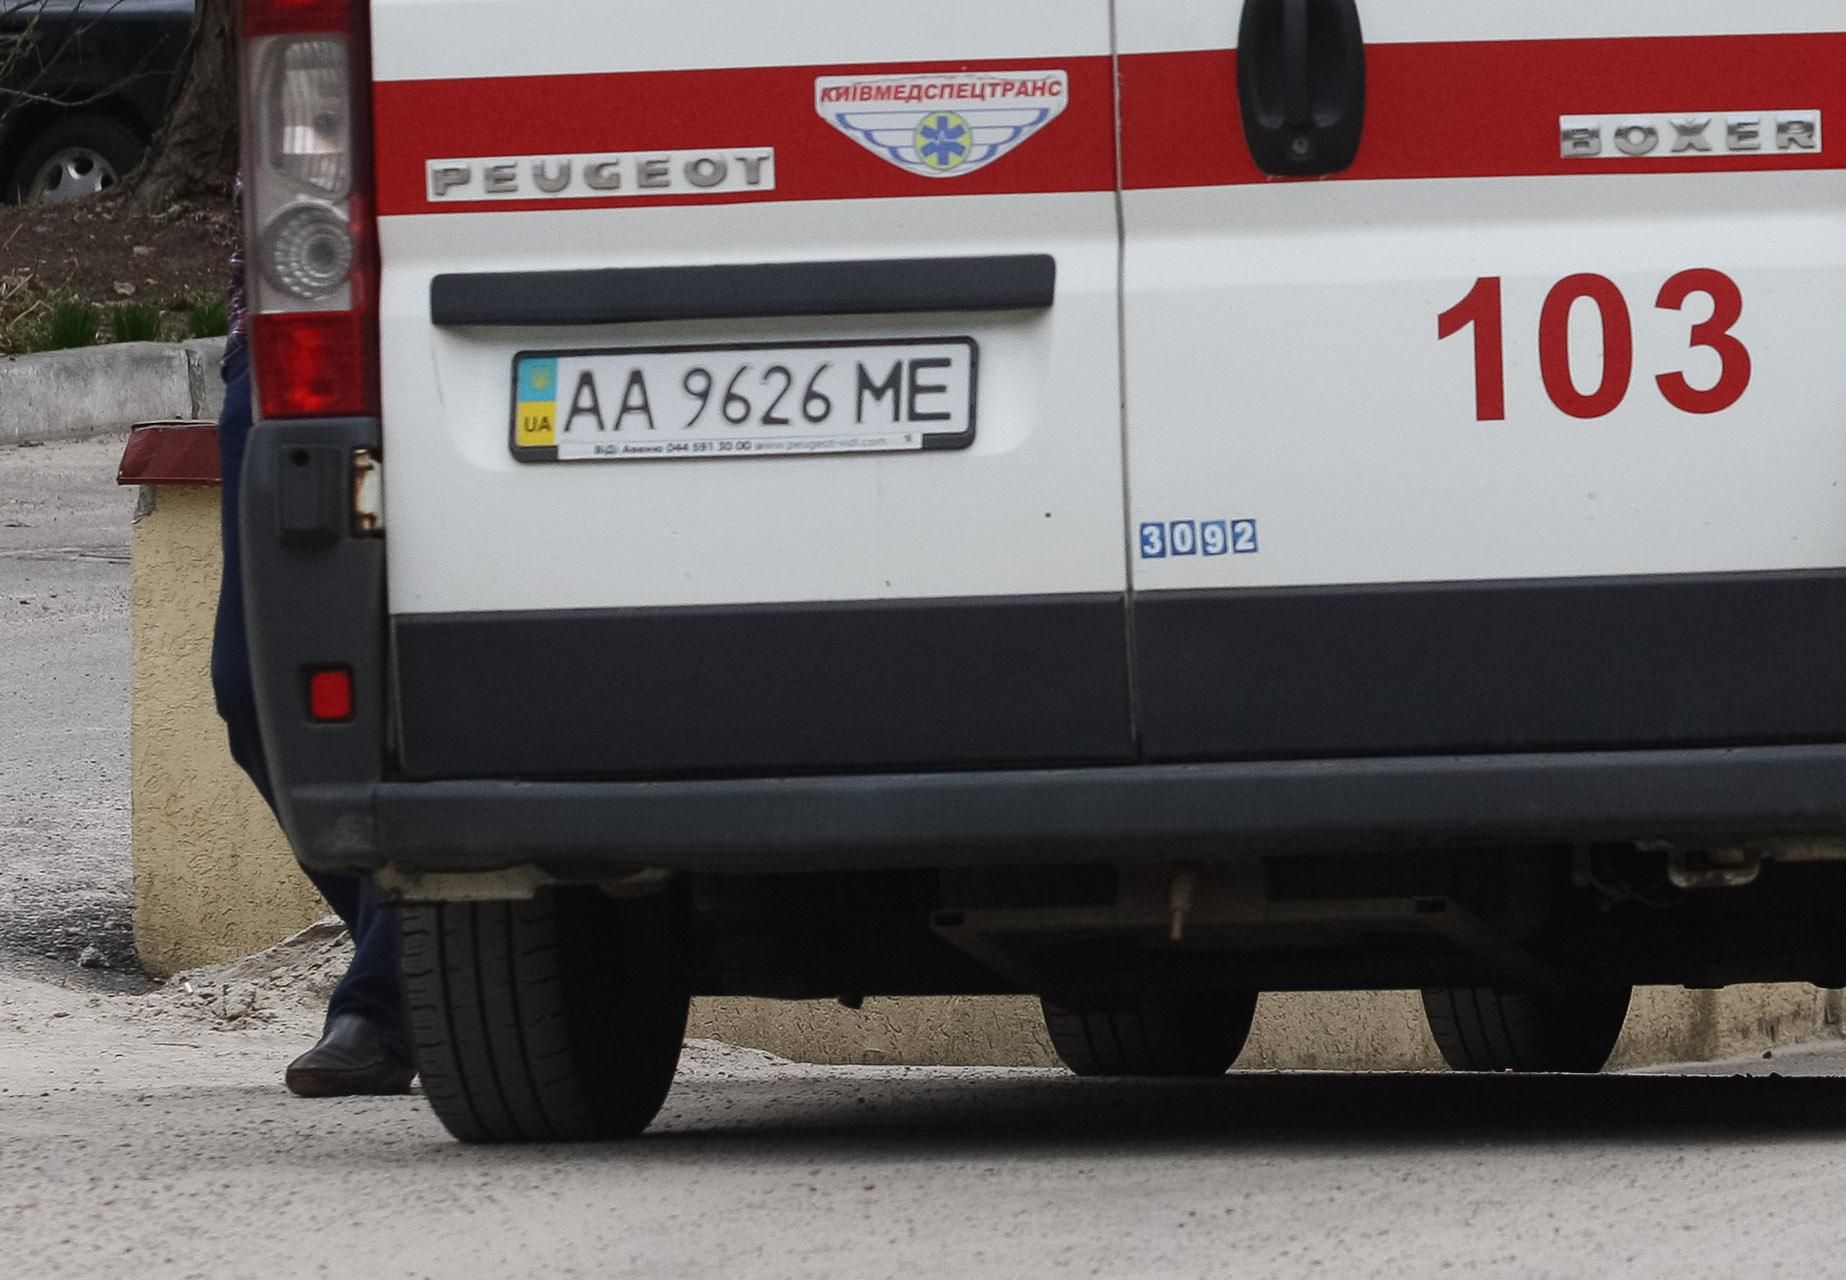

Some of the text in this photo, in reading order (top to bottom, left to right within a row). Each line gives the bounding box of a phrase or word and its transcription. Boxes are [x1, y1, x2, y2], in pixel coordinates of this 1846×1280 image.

[820, 80, 1062, 103] КИЇВМЕДСПЕЦТРАНС
[1560, 114, 1817, 156] BOXER
[432, 151, 772, 196] PEUGEOT
[1437, 267, 1752, 422] 103
[563, 357, 952, 432] AA 9626 ME
[523, 416, 552, 434] UA
[1140, 519, 1258, 557] 3092
